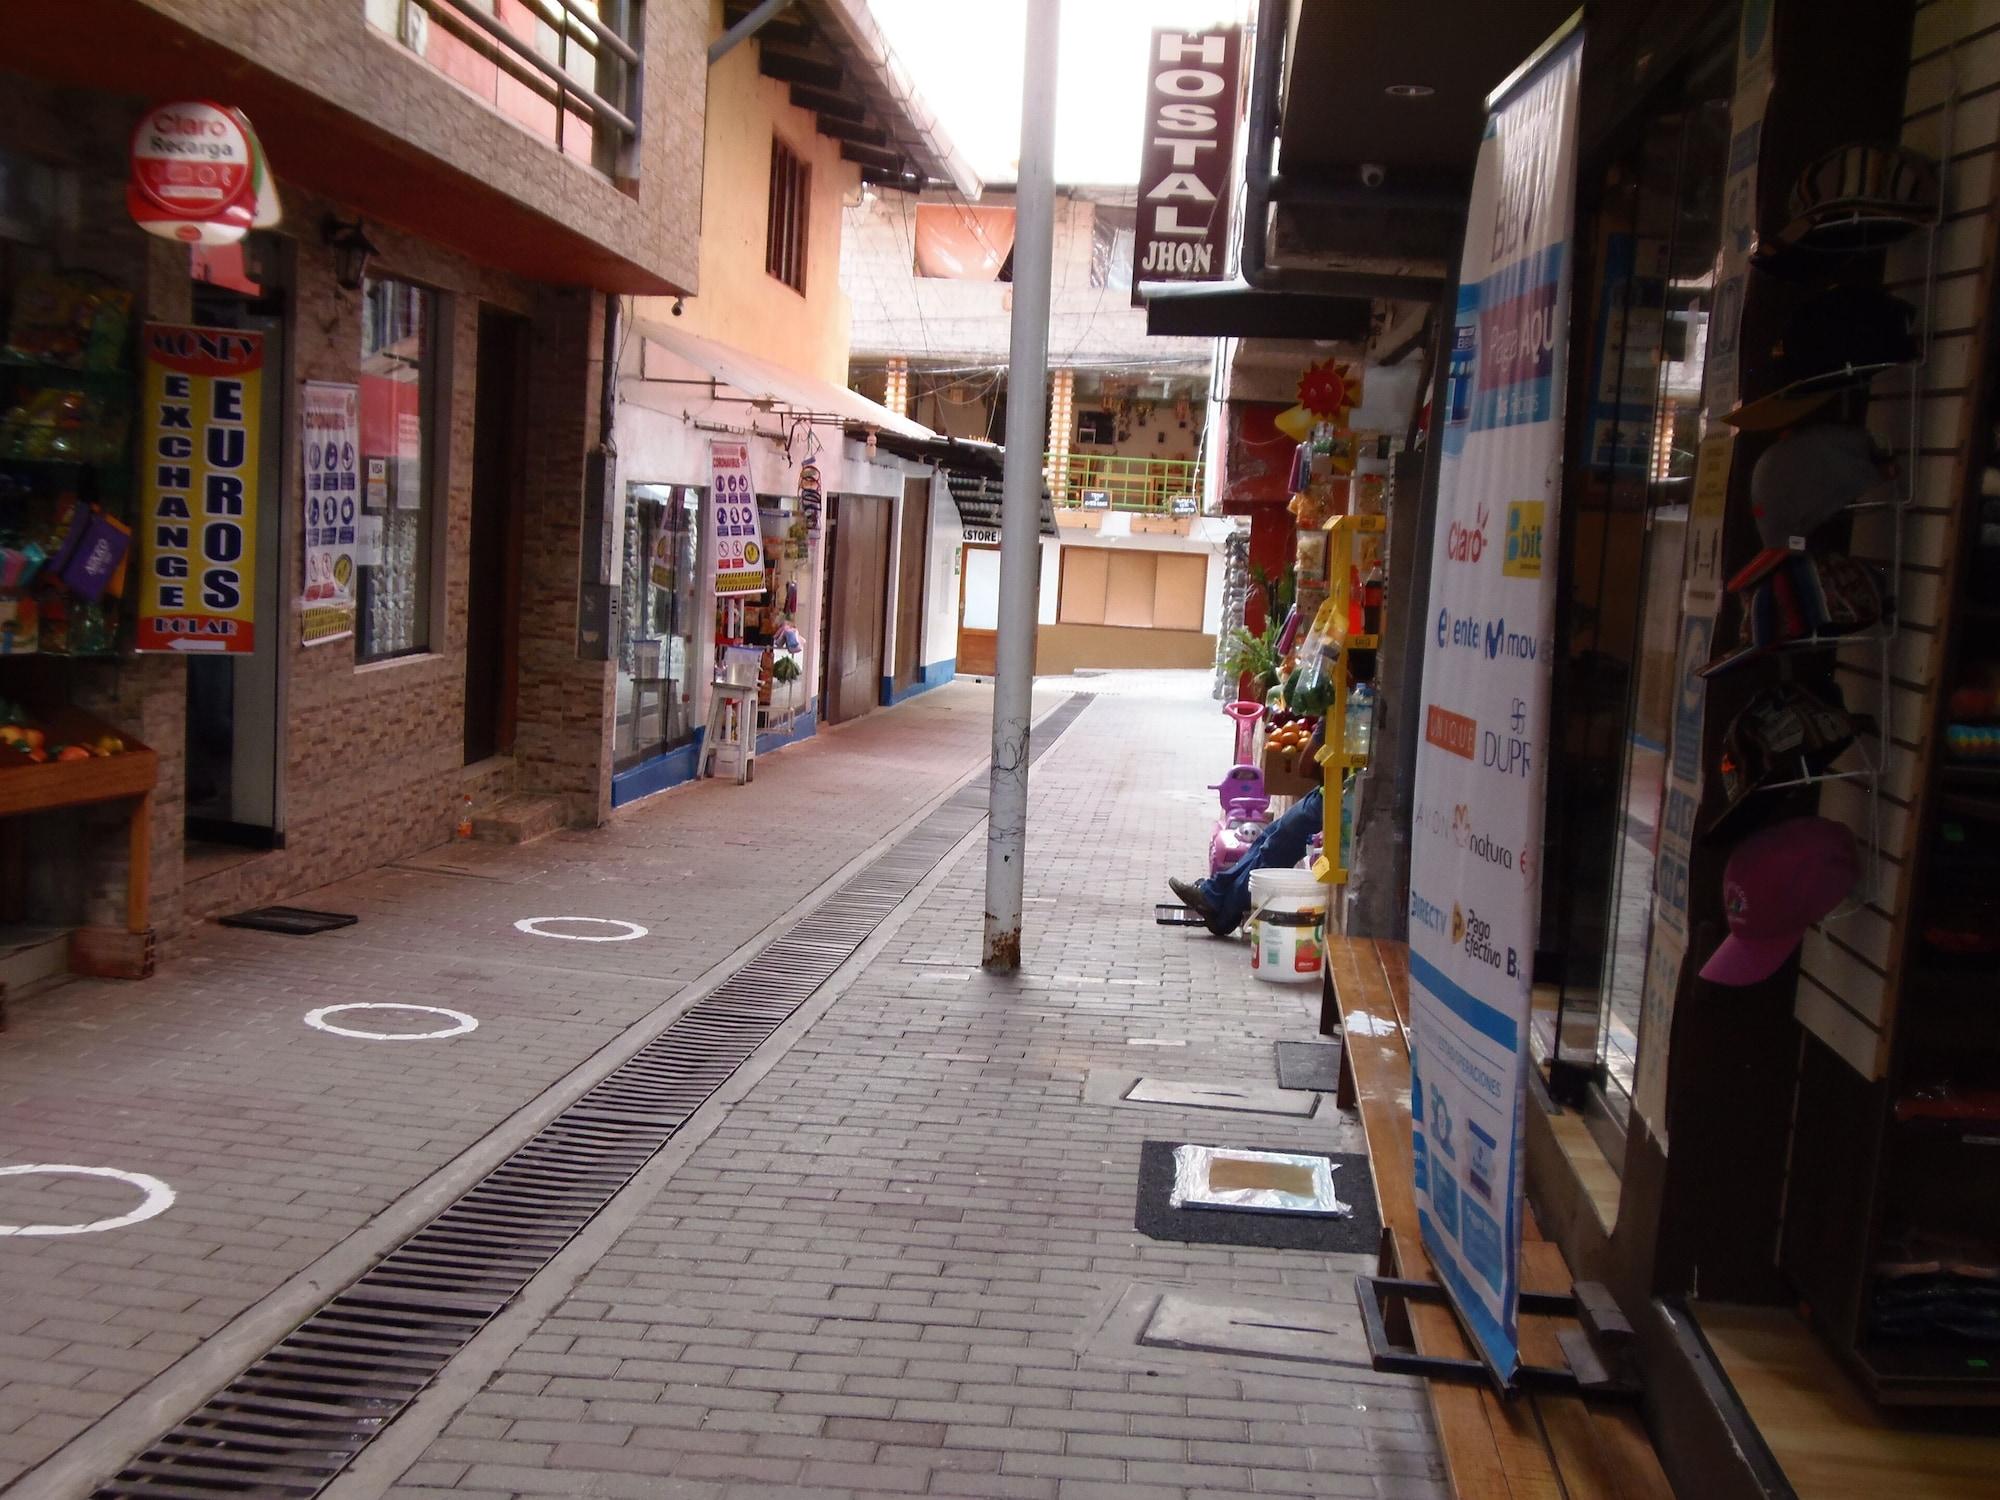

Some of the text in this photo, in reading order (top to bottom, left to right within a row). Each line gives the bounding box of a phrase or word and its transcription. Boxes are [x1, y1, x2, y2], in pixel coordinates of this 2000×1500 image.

[153, 112, 227, 138] Claro
[1147, 33, 1226, 236] HOSTAL
[149, 135, 235, 160] Recarga
[1142, 240, 1214, 274] JHON
[152, 330, 256, 365] MONEY
[371, 461, 384, 475] VISA
[154, 372, 193, 610] EXCHANGE
[201, 378, 246, 613] EUROS
[1448, 514, 1483, 564] Claro
[1520, 524, 1542, 559] bit
[1429, 712, 1474, 752] UNIQUE
[1469, 832, 1512, 871] natura
[1410, 889, 1448, 937] DIRECTV
[1467, 908, 1491, 943] Pago
[1464, 931, 1502, 969] Efectivo
